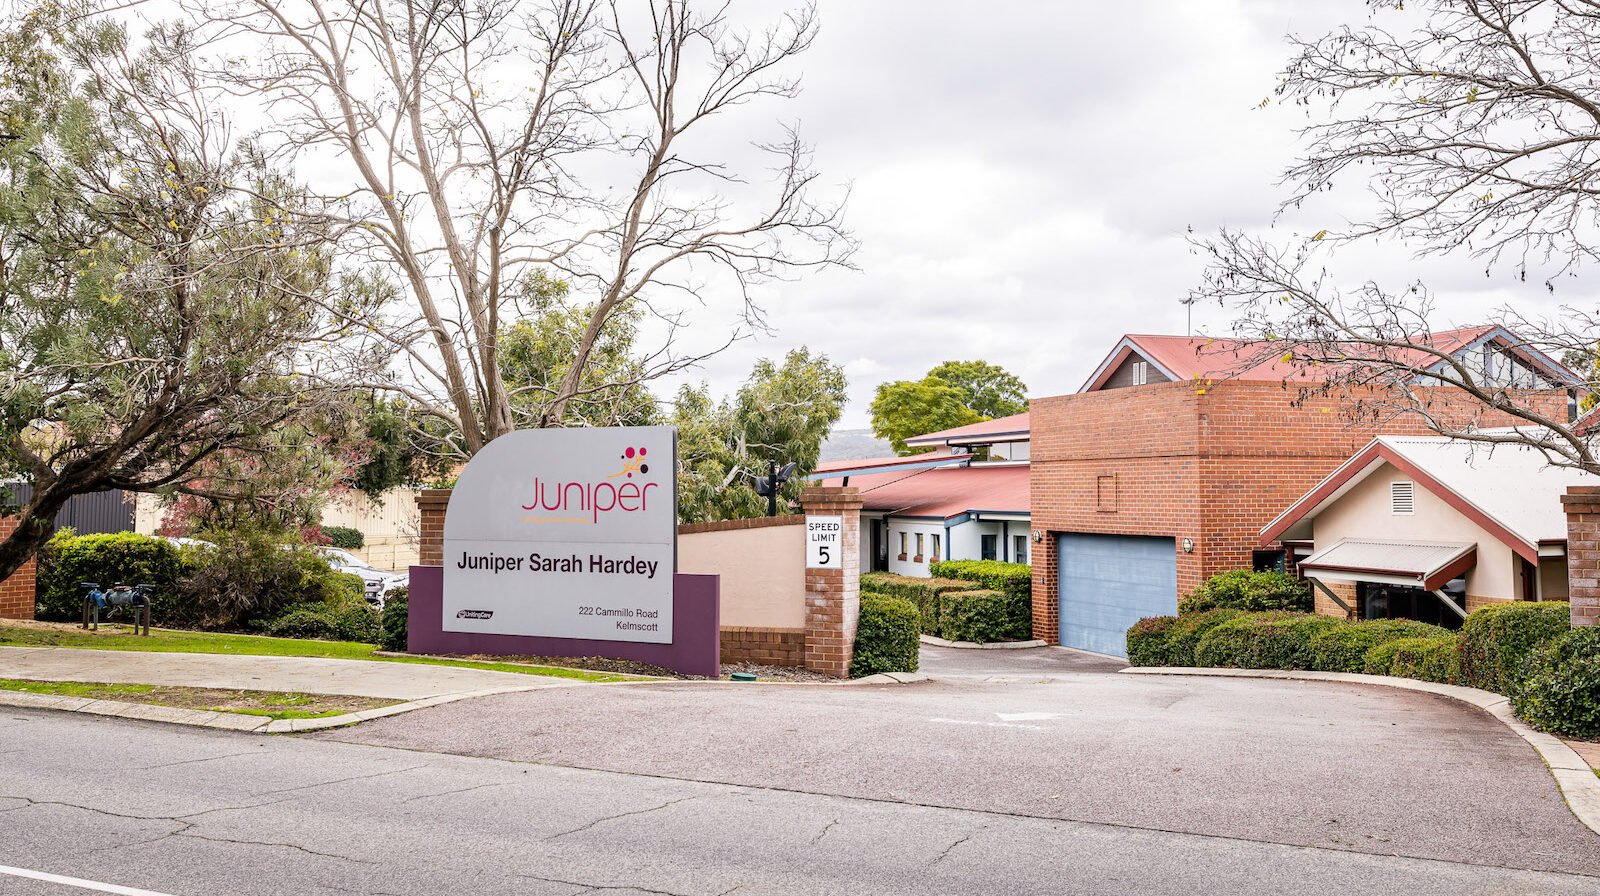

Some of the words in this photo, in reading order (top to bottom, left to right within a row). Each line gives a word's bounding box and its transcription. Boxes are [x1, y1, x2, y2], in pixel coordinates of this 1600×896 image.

[521, 477, 658, 524] Juniper
[809, 522, 839, 531] SPEED
[812, 534, 836, 542] LIMIT
[819, 546, 830, 565] 5
[457, 551, 524, 574] Juniper
[529, 553, 583, 573] Sarah
[589, 554, 658, 579] Hardey
[578, 606, 594, 616] 222
[595, 606, 634, 618] Cammillo
[636, 608, 658, 618] Road
[616, 621, 658, 632] Kelmscott
